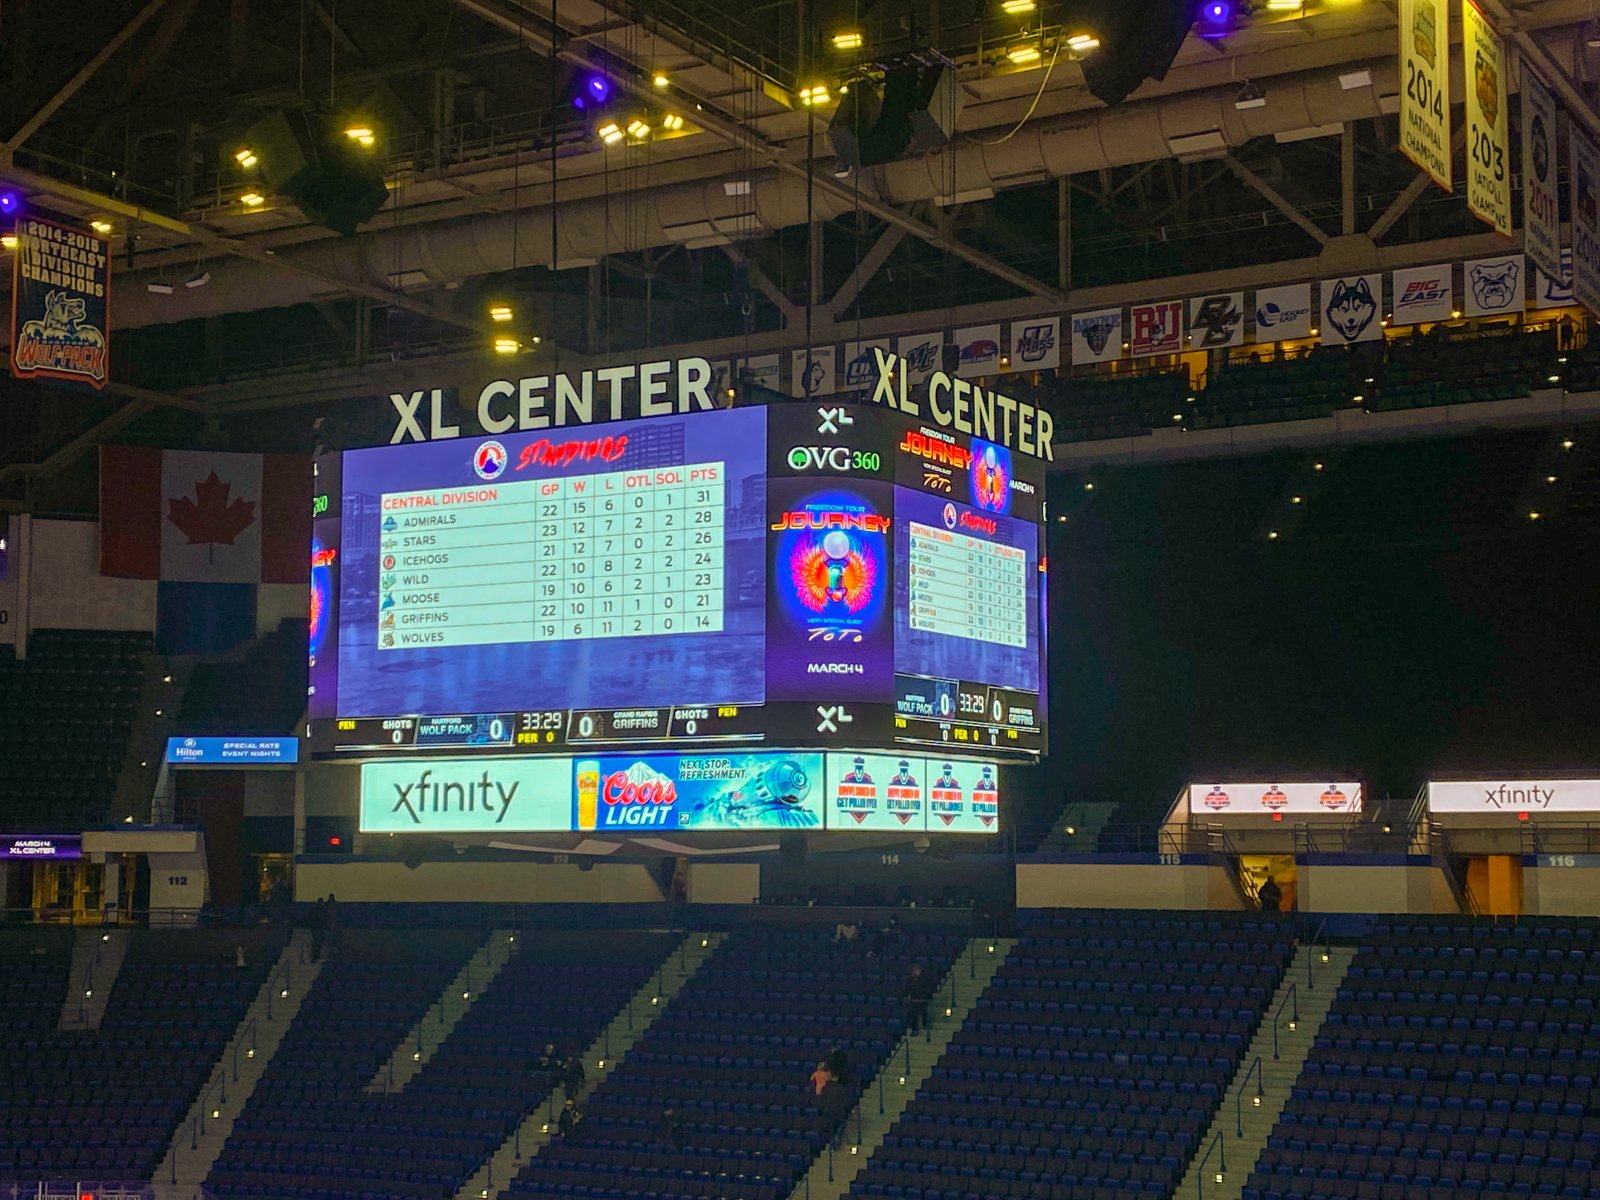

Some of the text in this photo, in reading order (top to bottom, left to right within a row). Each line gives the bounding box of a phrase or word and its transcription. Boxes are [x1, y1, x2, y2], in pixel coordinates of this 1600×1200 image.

[1407, 58, 1443, 126] 2014
[28, 221, 100, 253] 2014-2015
[22, 234, 106, 269] NORTHEAST
[31, 251, 95, 280] DIVISION
[21, 263, 104, 297] CHAMPIONS
[1405, 279, 1441, 293] BIG
[1400, 288, 1450, 302] EAST
[63, 344, 100, 371] PACK
[389, 357, 714, 445] XL CENTER
[873, 347, 1054, 462] XL CENTER
[817, 406, 854, 435] XL
[900, 431, 974, 471] JOURNEY
[383, 468, 717, 510] CENTRAL DIVISION GP W L OTL SOL PTS
[1009, 479, 1030, 493] MARCH
[403, 490, 710, 527] ADMIRALS 22 15 6 0 1 31
[805, 504, 865, 513] FREEDOM TOUR
[403, 511, 712, 547] STARS 23 12 7 2 2 28
[771, 512, 892, 534] JOURNEY
[403, 532, 712, 566] ICEHOGS 21 12 7 0 2 26
[403, 553, 711, 585] WILD 22 10 8 2 2 24
[402, 574, 711, 604] MOOSE 19 10 6 2 1 23
[401, 595, 709, 624] GRIFFINS 22 10 11 1 0 21
[401, 615, 710, 643] WOLVES 19 6 11 2 0 14
[807, 663, 864, 674] MARCH 4
[717, 707, 737, 717] PEN
[897, 700, 933, 715] WOLF PACK
[940, 693, 950, 715] 0
[959, 693, 985, 714] 33:29
[993, 700, 1002, 722] 0
[382, 720, 412, 729] SHOTS
[522, 711, 562, 730] 33:29
[613, 710, 658, 719] GRAND RAPIDS
[613, 718, 659, 729] GRIFFINS
[675, 709, 709, 720] SHOTS
[817, 705, 853, 733] XL
[338, 720, 356, 730] PEN
[419, 723, 473, 735] WOLF PACK
[489, 719, 503, 739] 0
[579, 716, 593, 737] 0
[686, 721, 697, 735] 0
[392, 730, 402, 743] 0
[517, 731, 554, 743] PER 0
[942, 729, 948, 742] 0
[973, 730, 979, 742] 0
[991, 734, 997, 746] 0
[176, 747, 204, 757] Hilton
[680, 759, 730, 769] NEXT STOP:
[680, 769, 748, 780] REFRESHMENT.
[391, 768, 520, 824] xfinity
[602, 770, 678, 806] Coors
[1485, 784, 1555, 809] xfinity
[836, 797, 848, 808] GET
[605, 805, 673, 825] LIGHT
[881, 854, 899, 865] 114
[1549, 855, 1575, 867] 116
[167, 875, 188, 886] 112
